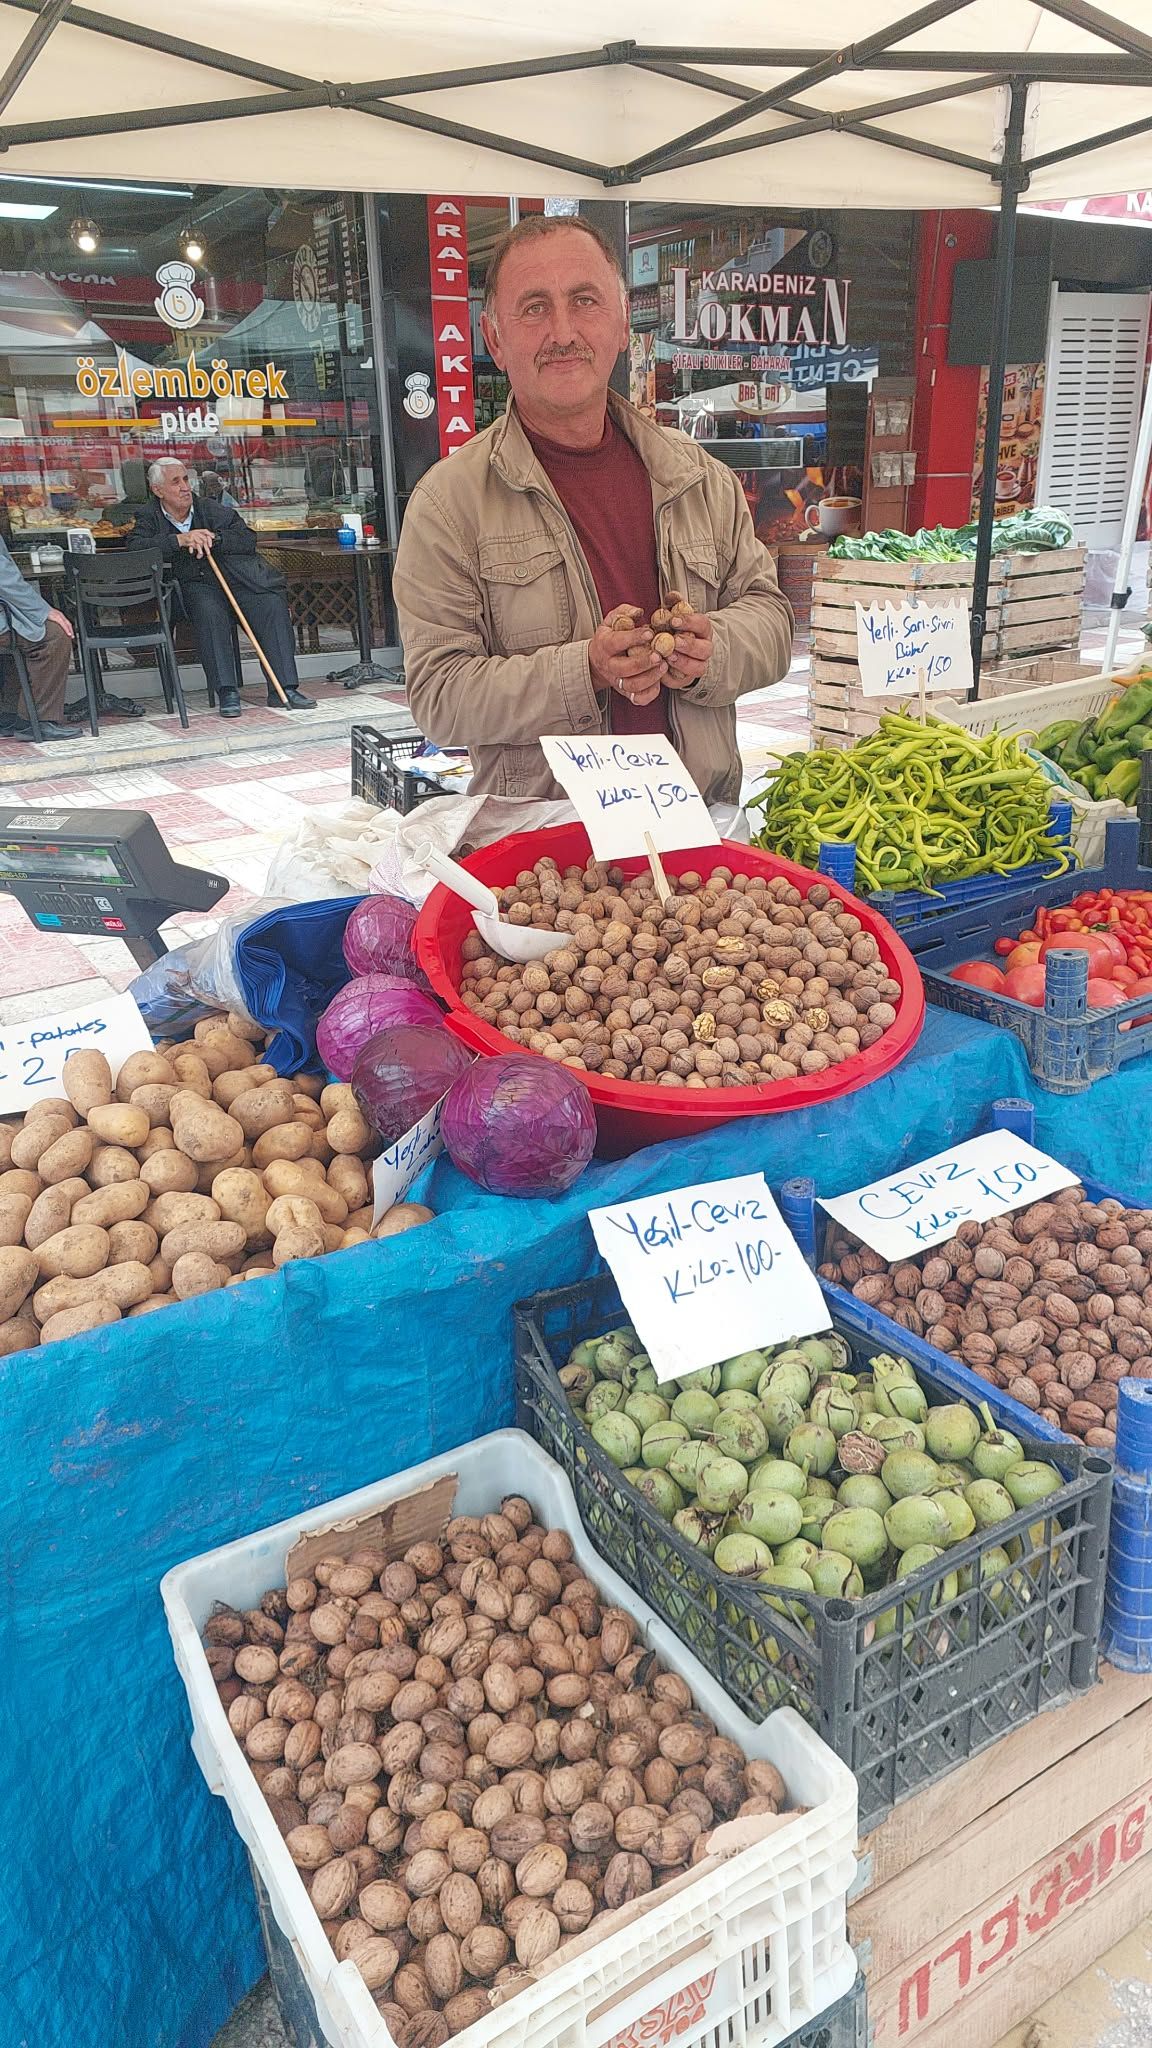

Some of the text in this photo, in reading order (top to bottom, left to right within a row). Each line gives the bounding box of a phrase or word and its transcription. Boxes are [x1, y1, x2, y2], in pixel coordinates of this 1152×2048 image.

[671, 267, 851, 345] LOKMAN
[76, 348, 289, 398] özlembörek
[751, 355, 791, 371] BAHARAT
[161, 406, 219, 441] pide
[927, 656, 952, 682] 150
[23, 1047, 81, 1086] 2
